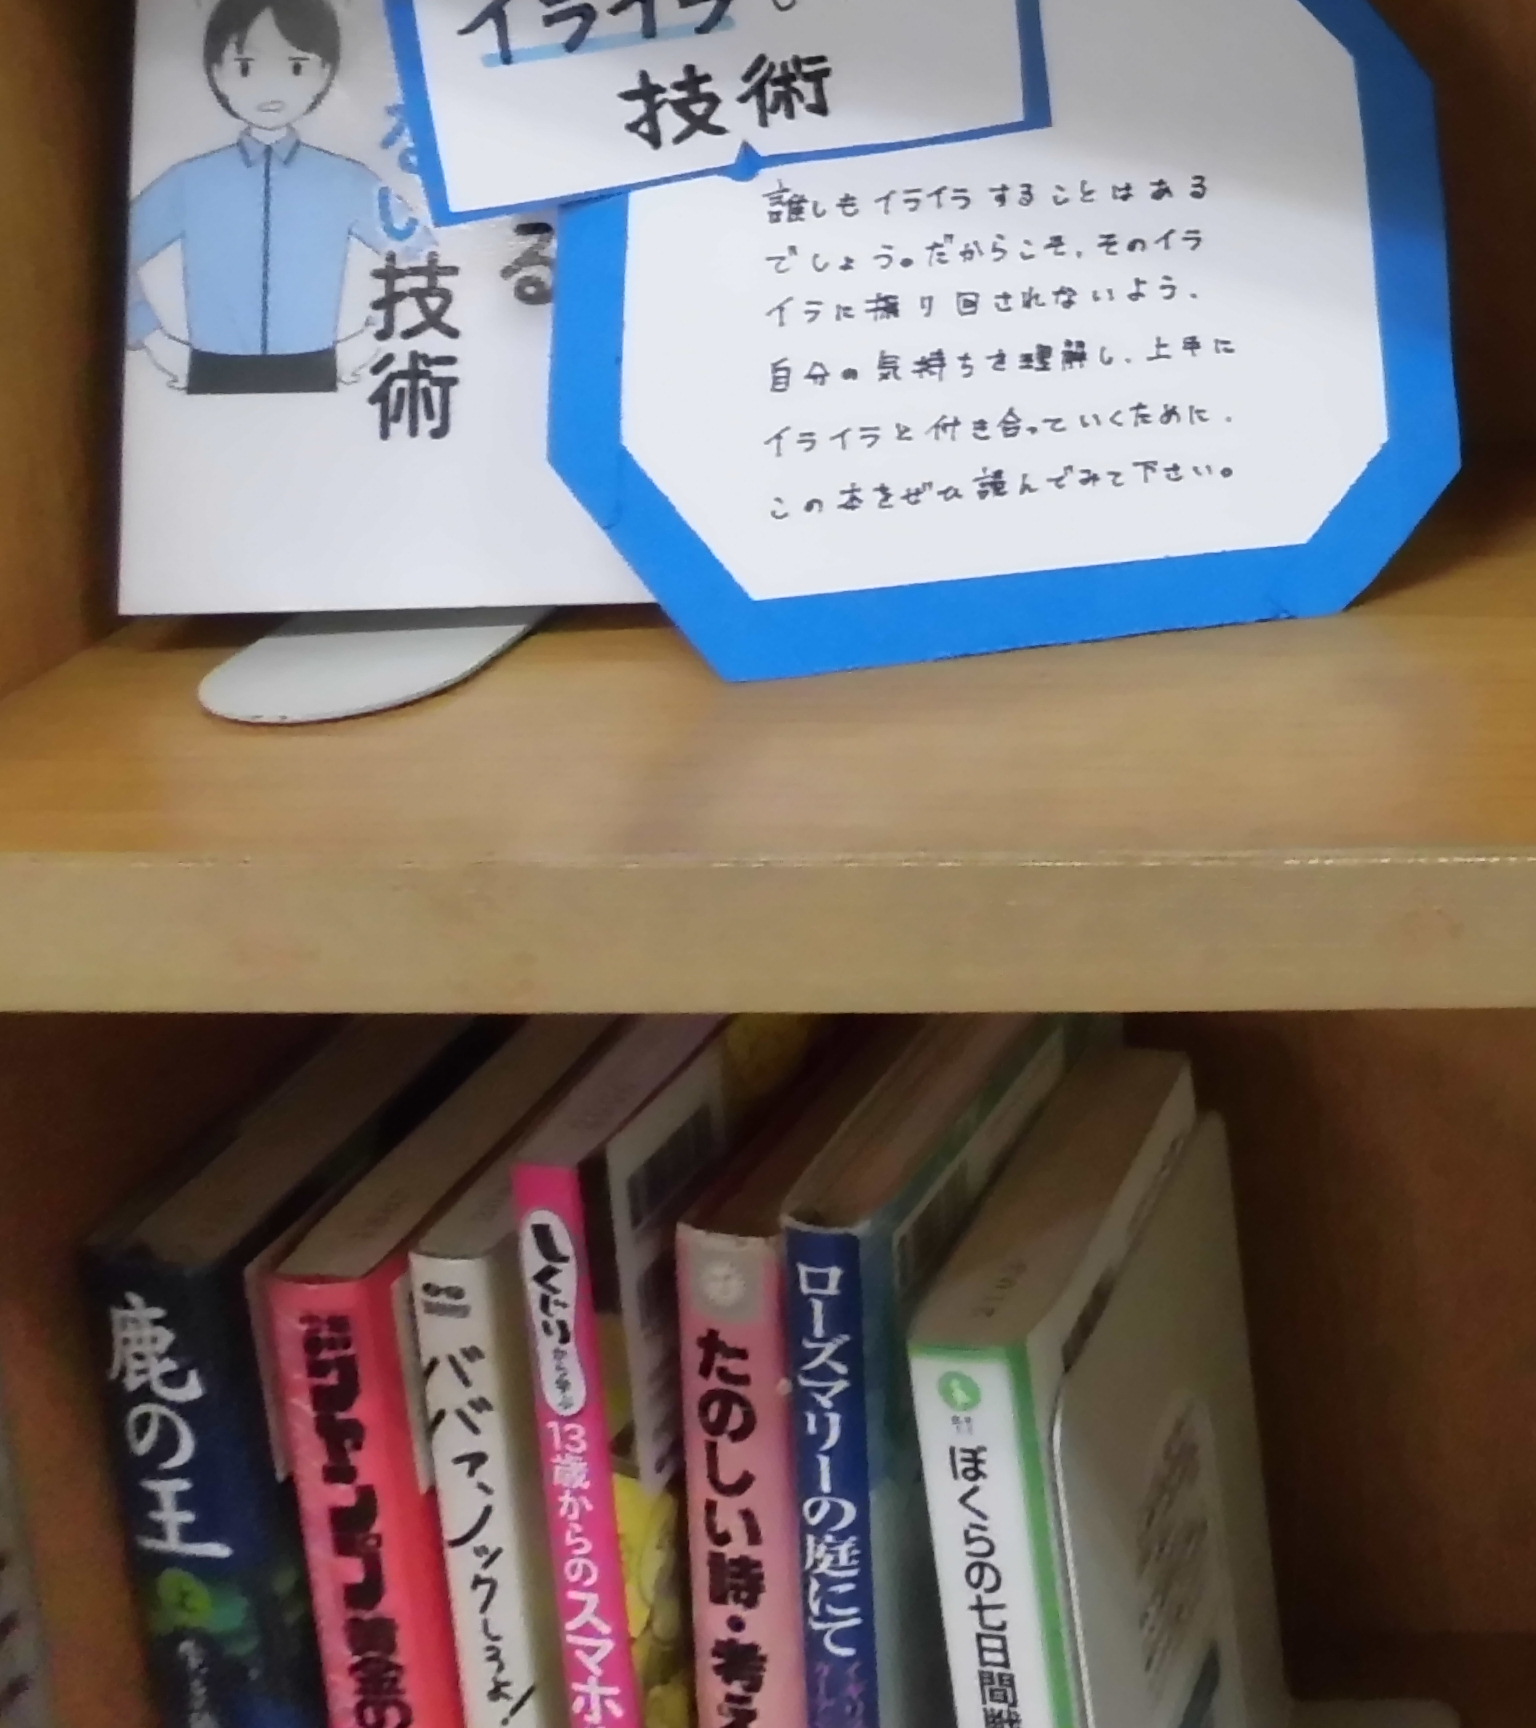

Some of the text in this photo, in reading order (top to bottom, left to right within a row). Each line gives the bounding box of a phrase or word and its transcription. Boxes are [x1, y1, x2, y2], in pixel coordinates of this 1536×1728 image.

[618, 51, 834, 151] 技術
[107, 1291, 234, 1560] 鹿の王
[795, 1259, 863, 1658] ローズマリーの庭にて
[546, 1420, 625, 1728] 13歳からのスマホ
